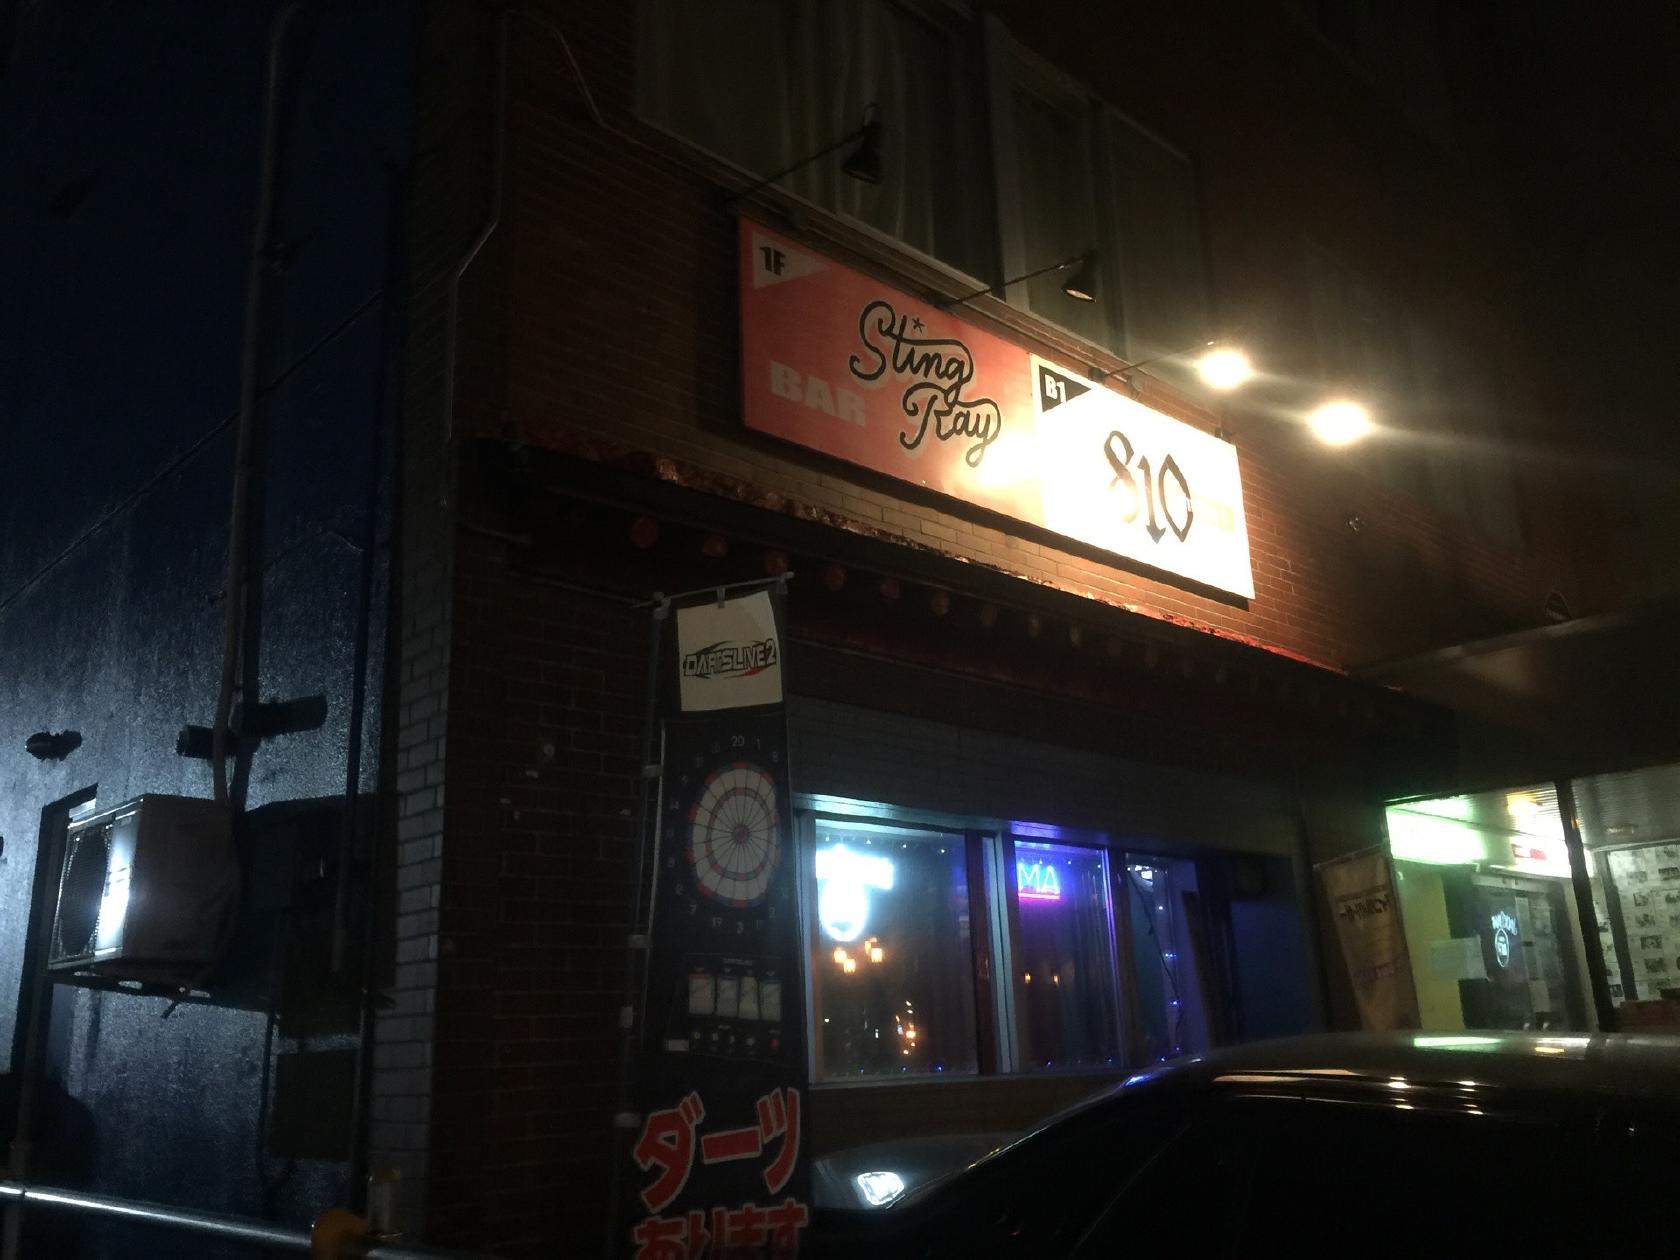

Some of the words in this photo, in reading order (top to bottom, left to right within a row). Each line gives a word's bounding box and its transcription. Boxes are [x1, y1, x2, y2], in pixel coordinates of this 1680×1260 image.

[760, 246, 786, 276] 1F
[849, 300, 974, 403] Sting
[768, 360, 866, 427] BAR
[1044, 373, 1067, 403] B1
[900, 381, 1002, 468] Ray
[731, 735, 745, 747] 20
[633, 1087, 800, 1214] ダーツ
